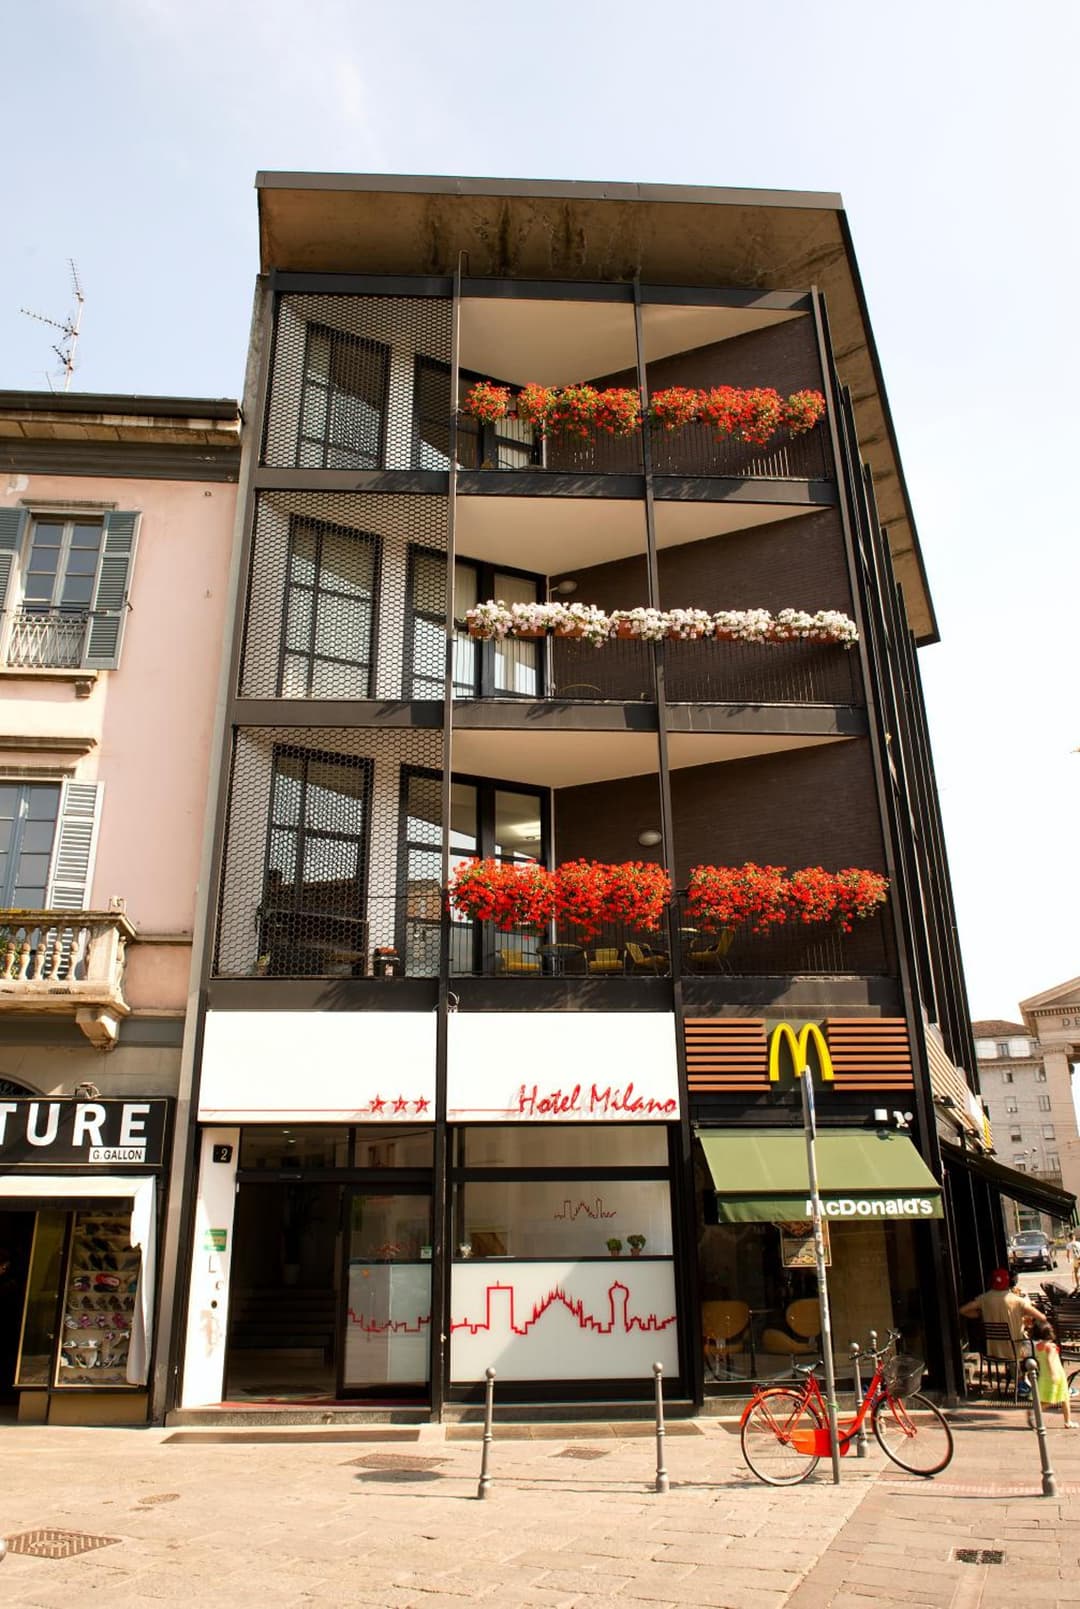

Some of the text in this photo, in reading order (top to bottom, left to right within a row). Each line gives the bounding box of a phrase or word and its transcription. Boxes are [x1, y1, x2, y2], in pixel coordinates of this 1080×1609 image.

[518, 1081, 677, 1115] Hotel Milano
[0, 1102, 150, 1147] TURE
[220, 1147, 228, 1161] 2
[806, 1198, 933, 1216] McDonald's
